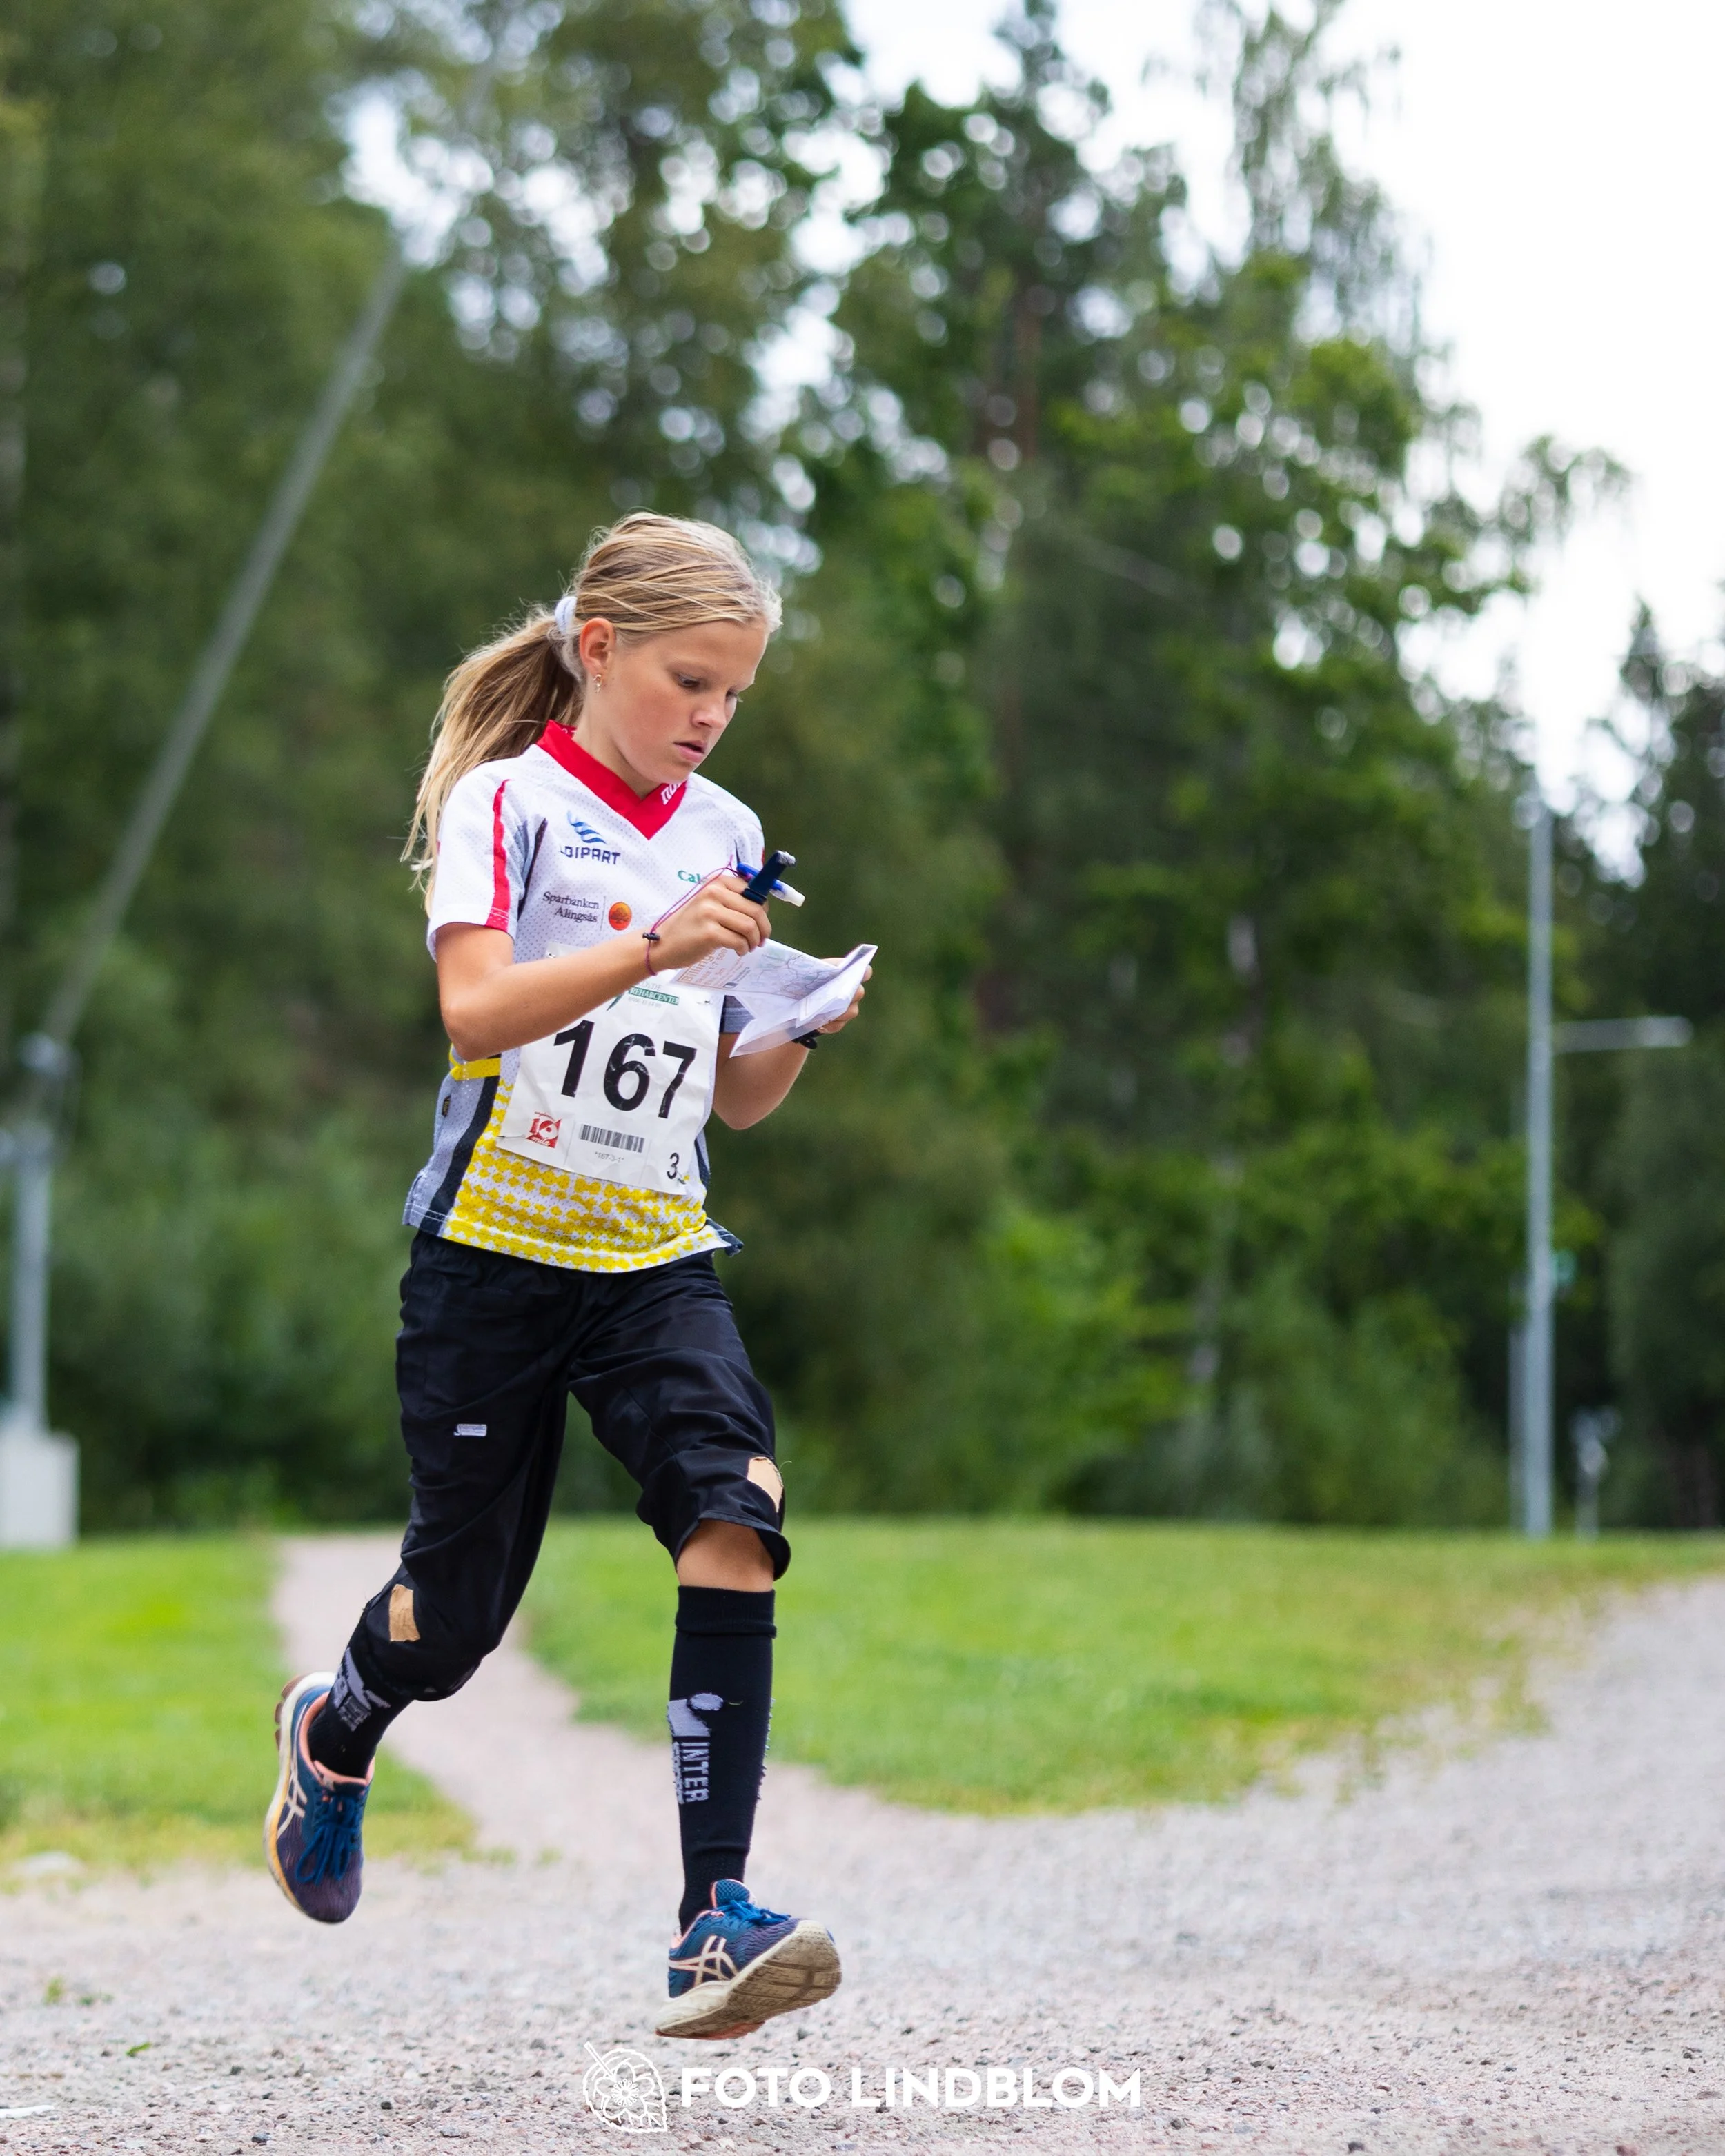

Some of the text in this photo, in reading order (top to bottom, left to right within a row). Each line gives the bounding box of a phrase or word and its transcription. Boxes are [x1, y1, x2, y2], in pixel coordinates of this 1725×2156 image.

[542, 891, 600, 909] Sparbanken
[555, 907, 598, 923] Alingsås
[553, 1020, 697, 1119] 167
[667, 1152, 680, 1179] 3
